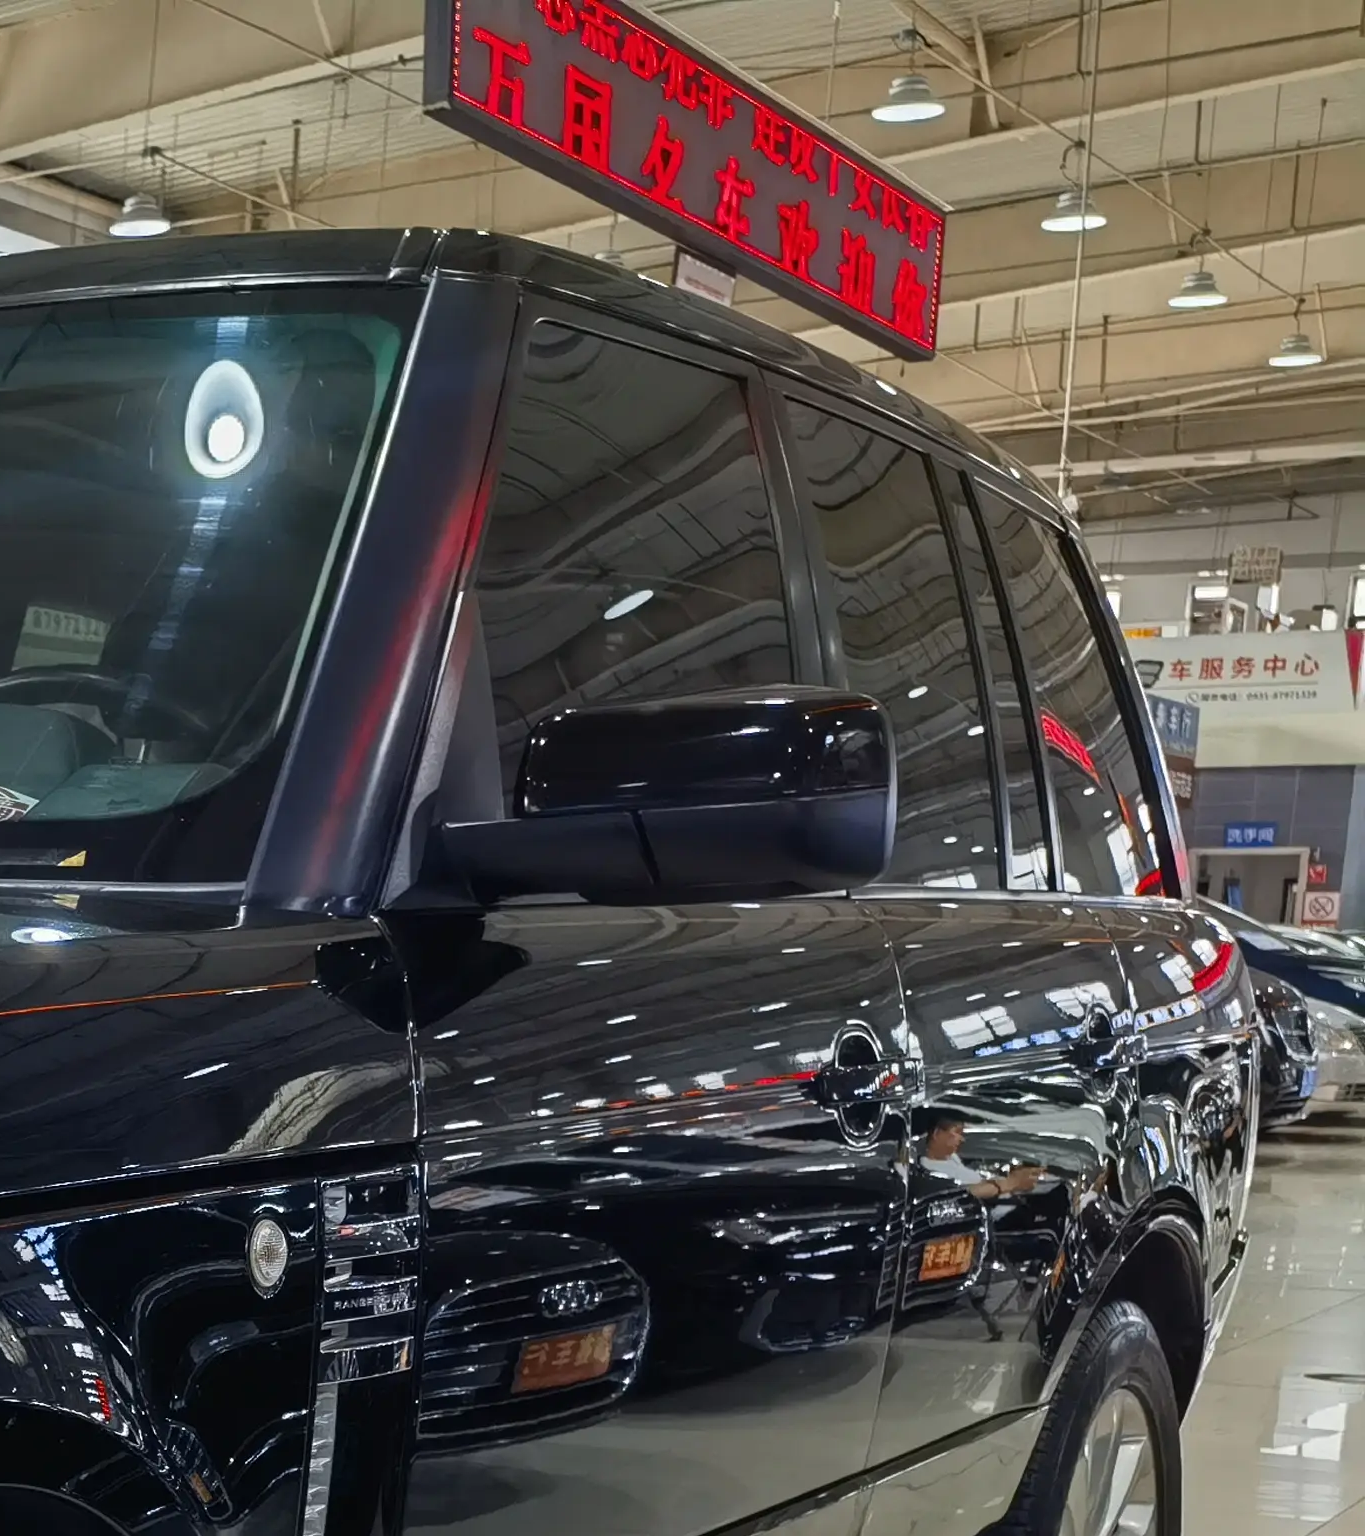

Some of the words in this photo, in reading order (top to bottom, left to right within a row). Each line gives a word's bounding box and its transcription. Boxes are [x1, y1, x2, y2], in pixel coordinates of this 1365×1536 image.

[1168, 653, 1319, 681] 车服务中心
